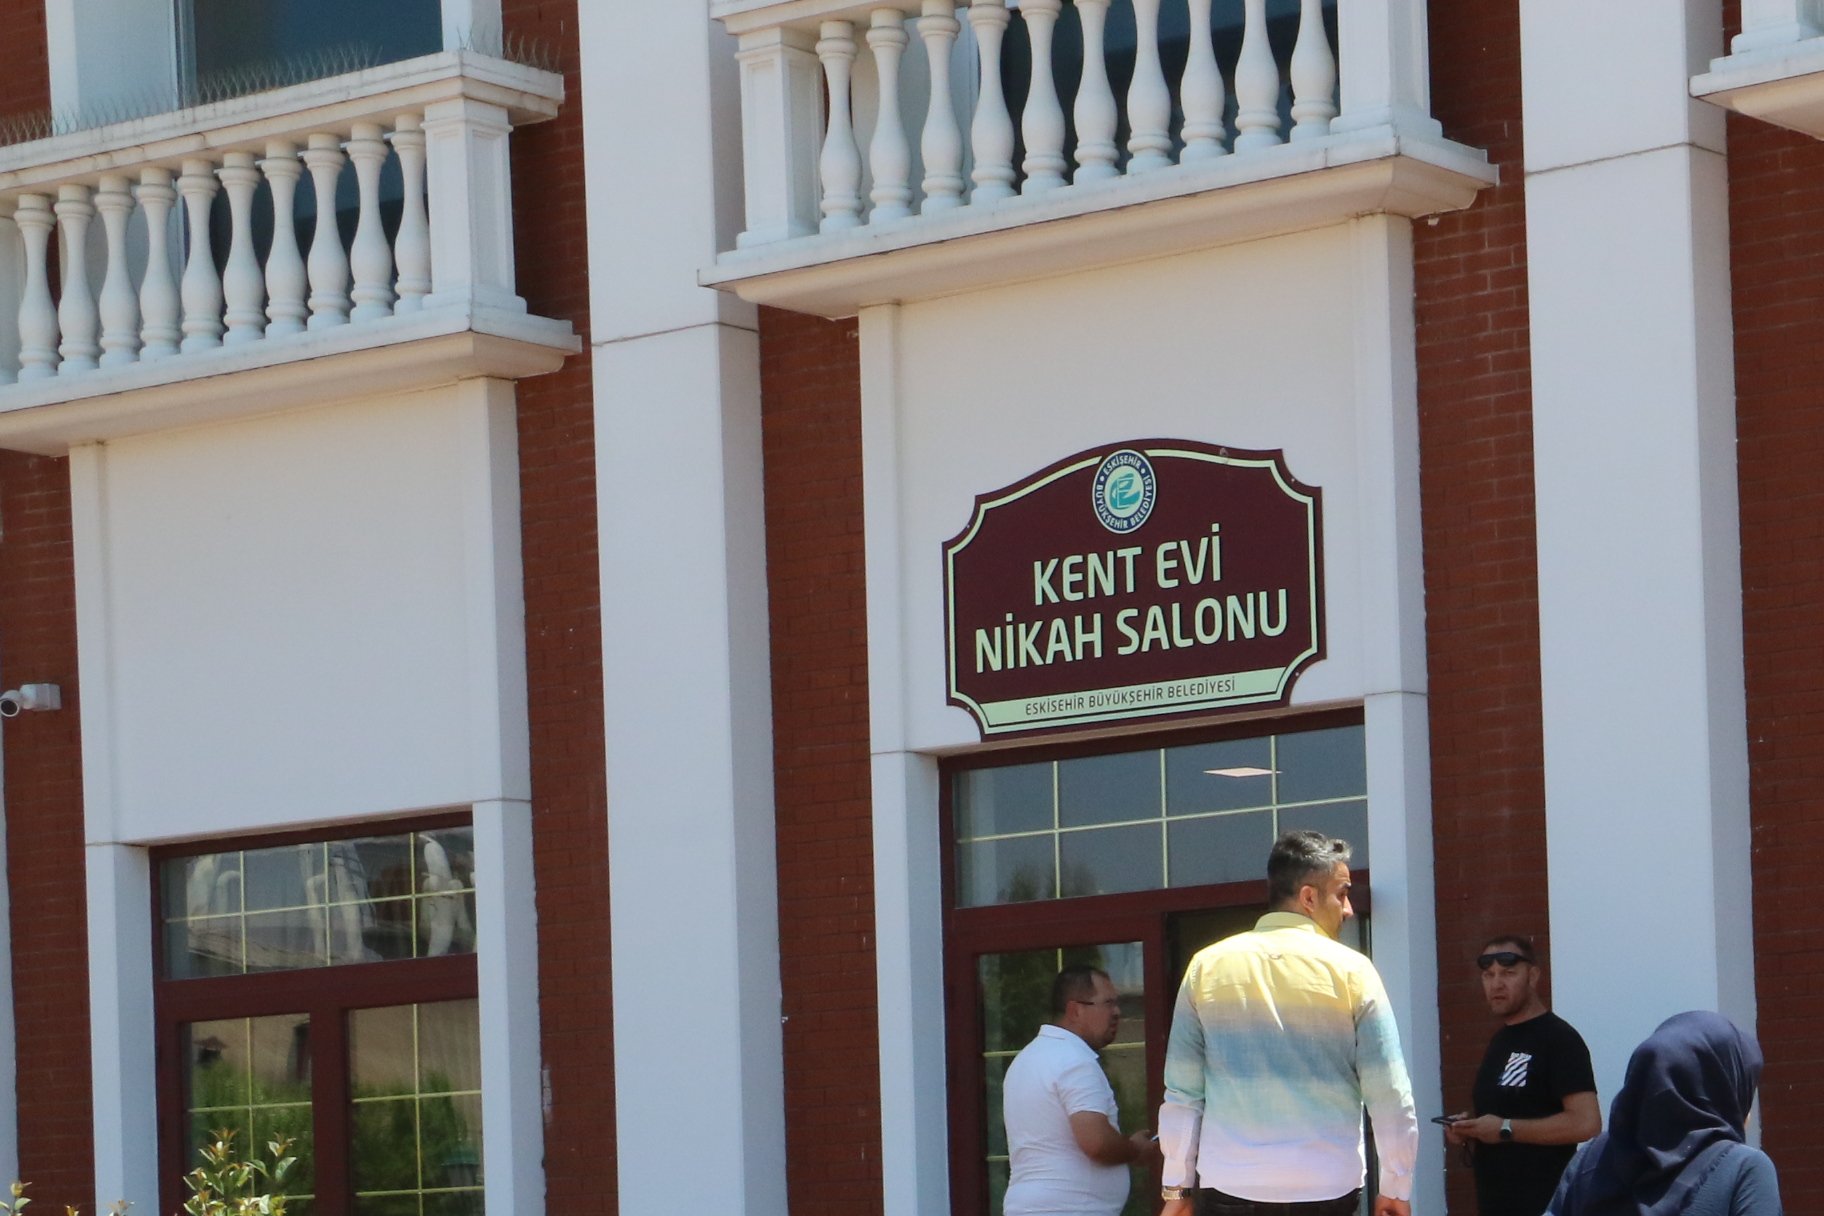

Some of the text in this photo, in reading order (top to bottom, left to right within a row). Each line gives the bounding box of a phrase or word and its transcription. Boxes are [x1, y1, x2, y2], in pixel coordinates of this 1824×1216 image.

[1103, 455, 1142, 475] ESKİŞEHİR
[1033, 523, 1221, 606] KENT EVİ
[975, 588, 1288, 674] NİKAH SALONU
[1088, 687, 1163, 706] BÜYÜKŞEHİR
[1167, 676, 1236, 698] BELEDİYESİ
